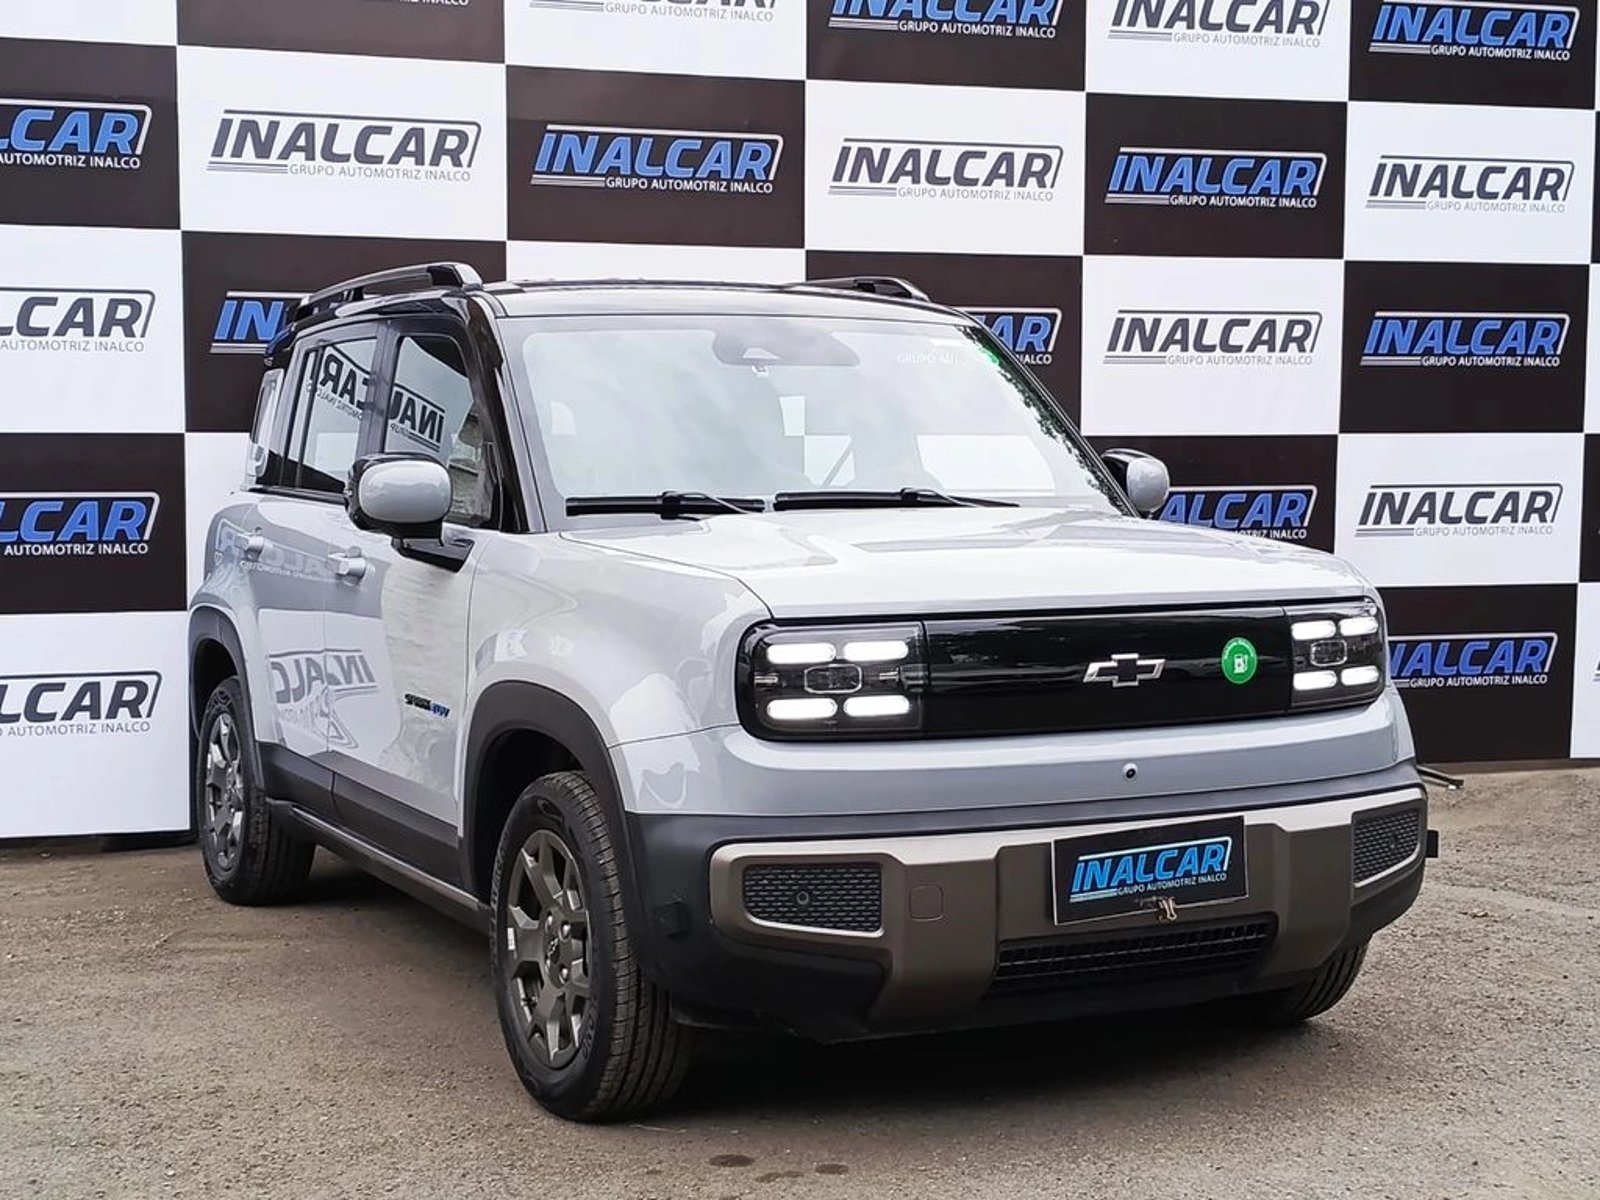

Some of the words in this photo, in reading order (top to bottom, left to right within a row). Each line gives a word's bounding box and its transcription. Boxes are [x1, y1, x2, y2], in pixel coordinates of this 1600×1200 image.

[605, 3, 647, 14] GRUPO
[651, 5, 727, 18] AUTOMOTRIZ
[731, 9, 773, 21] INALCO
[1111, 0, 1320, 35] INALCAR
[899, 20, 938, 33] GRUPO
[941, 22, 1012, 36] AUTOMOTRIZ
[1015, 26, 1056, 38] INALCO
[1372, 5, 1570, 48] INALCAR
[1174, 32, 1210, 43] GRUPO
[1212, 34, 1280, 46] AUTOMOTRIZ
[1283, 37, 1320, 48] INALCO
[1431, 44, 1466, 56] GRUPO
[1469, 46, 1532, 59] AUTOMOTRIZ
[1534, 49, 1570, 61] INALCO
[0, 108, 139, 155] CAR
[211, 118, 470, 168] INALCAR
[90, 156, 141, 169] INALCO
[534, 133, 773, 180] INALCAR
[290, 163, 335, 176] GRUPO
[339, 167, 421, 180] AUTOMOTRIZ
[425, 170, 471, 182] INALCO
[832, 146, 1053, 189] INALCAR
[1108, 155, 1317, 195] INALCAR
[606, 177, 647, 189] GRUPO
[651, 179, 727, 192] AUTOMOTRIZ
[730, 182, 773, 194] INALCO
[1369, 163, 1565, 201] INALCAR
[898, 187, 937, 198] GRUPO
[940, 189, 1010, 200] AUTOMOTRIZ
[1013, 190, 1054, 202] INALCO
[1169, 195, 1207, 206] GRUPO
[1209, 196, 1276, 207] AUTOMOTRIZ
[1279, 197, 1317, 208] INALCO
[1427, 201, 1461, 211] GRUPO
[1464, 202, 1527, 212] AUTOMOTRIZ
[1530, 203, 1565, 213] INALCO
[1106, 317, 1313, 353] INALCAR
[1364, 319, 1560, 355] INALCAR
[0, 339, 91, 351] AUTOMOTRIZ
[95, 341, 145, 352] INALCO
[1168, 355, 1204, 365] GRUPO
[1207, 356, 1272, 366] AUTOMOTRIZ
[1275, 355, 1313, 365] INALCO
[1422, 356, 1457, 366] GRUPO
[1459, 357, 1521, 367] AUTOMOTRIZ
[1523, 357, 1560, 367] INALCO
[1358, 491, 1553, 525] INALCAR
[1270, 529, 1307, 539] INALCO
[1416, 527, 1450, 537] GRUPO
[1452, 526, 1515, 536] AUTOMOTRIZ
[1518, 525, 1553, 535] INALCO
[4, 543, 95, 556] AUTOMOTRIZ
[99, 542, 149, 554] INALCO
[1410, 677, 1444, 688] GRUPO
[1446, 676, 1510, 687] AUTOMOTRIZ
[1512, 674, 1548, 684] INALCO
[8, 723, 96, 737] AUTOMOTRIZ
[101, 721, 150, 734] INALCO
[1071, 844, 1224, 892] INALCAR
[1117, 884, 1145, 896] GRUPO
[1146, 877, 1197, 892] AUTOMOTRIZ
[1198, 873, 1227, 884] INALCO
